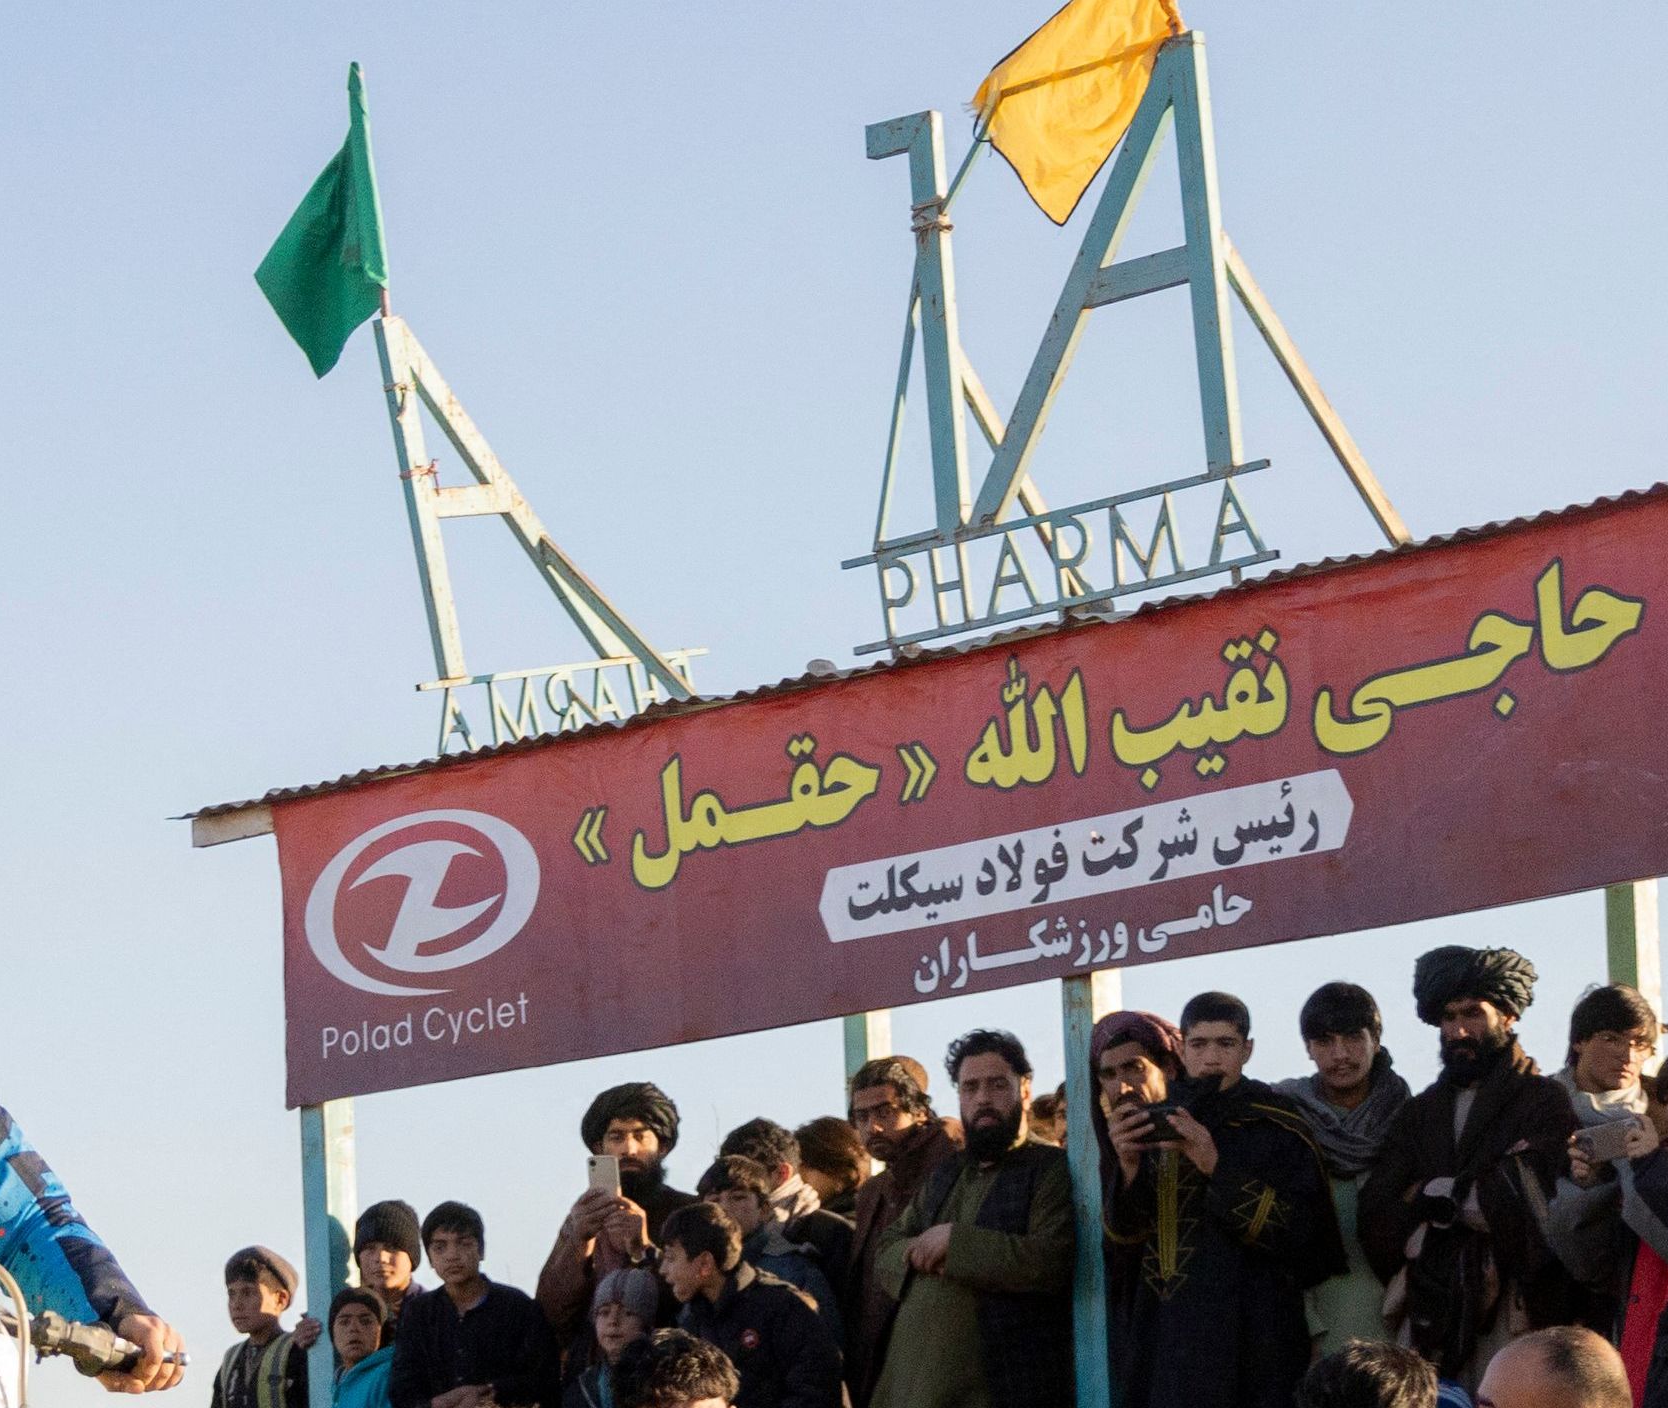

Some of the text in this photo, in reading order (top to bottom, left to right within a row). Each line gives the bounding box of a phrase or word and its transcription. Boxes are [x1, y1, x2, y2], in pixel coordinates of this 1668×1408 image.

[876, 476, 1268, 640] PHARMA
[963, 652, 1089, 793] الله
[1109, 626, 1290, 792] نقیب
[1312, 556, 1646, 760] حاجی
[847, 780, 1321, 922] رئیس شرکت فولاد سیکلت
[912, 884, 1254, 994] حامی ورزشکاران
[321, 991, 531, 1061] Polad Cyclet
